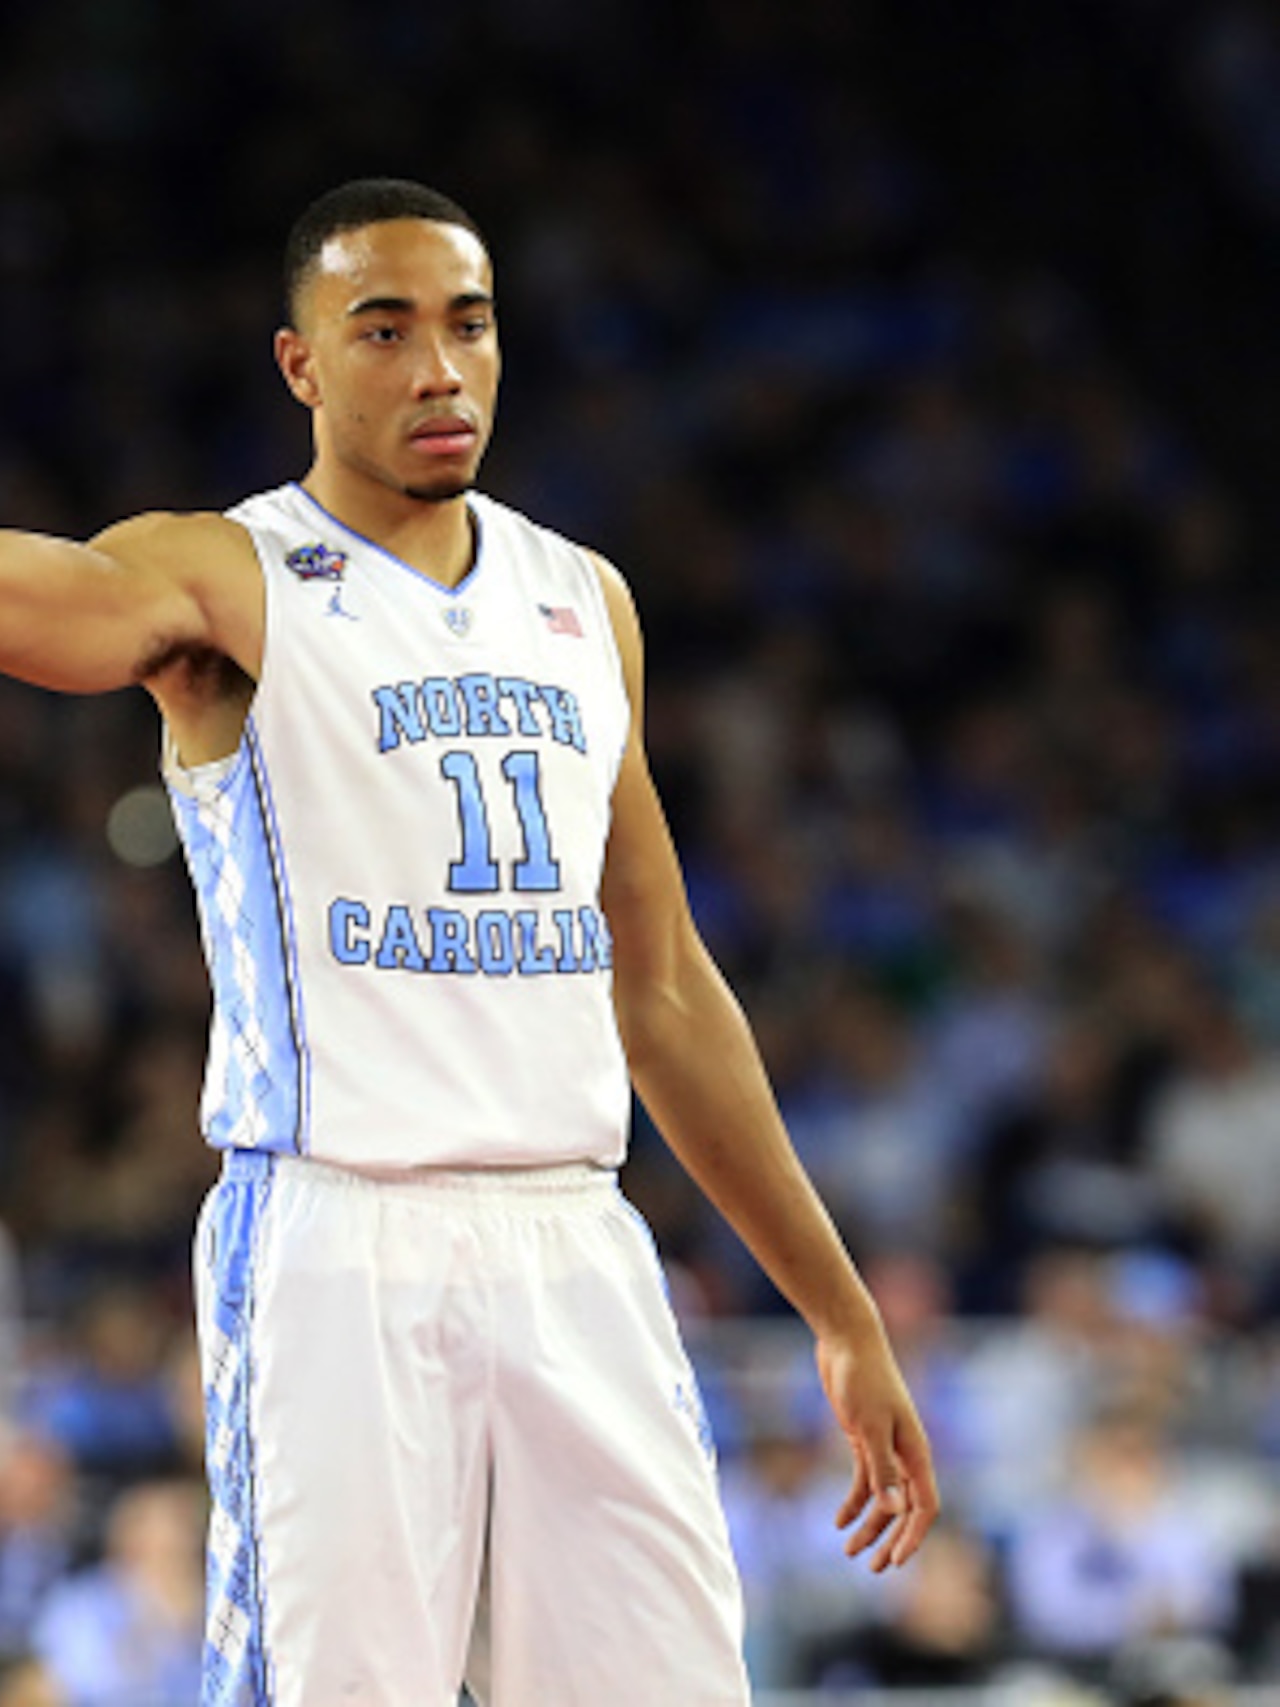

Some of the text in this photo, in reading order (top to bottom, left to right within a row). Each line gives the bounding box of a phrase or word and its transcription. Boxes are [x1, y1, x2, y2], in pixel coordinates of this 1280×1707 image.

[372, 674, 587, 754] NORTH
[440, 751, 561, 892] 11
[328, 898, 613, 975] CAROLIN
